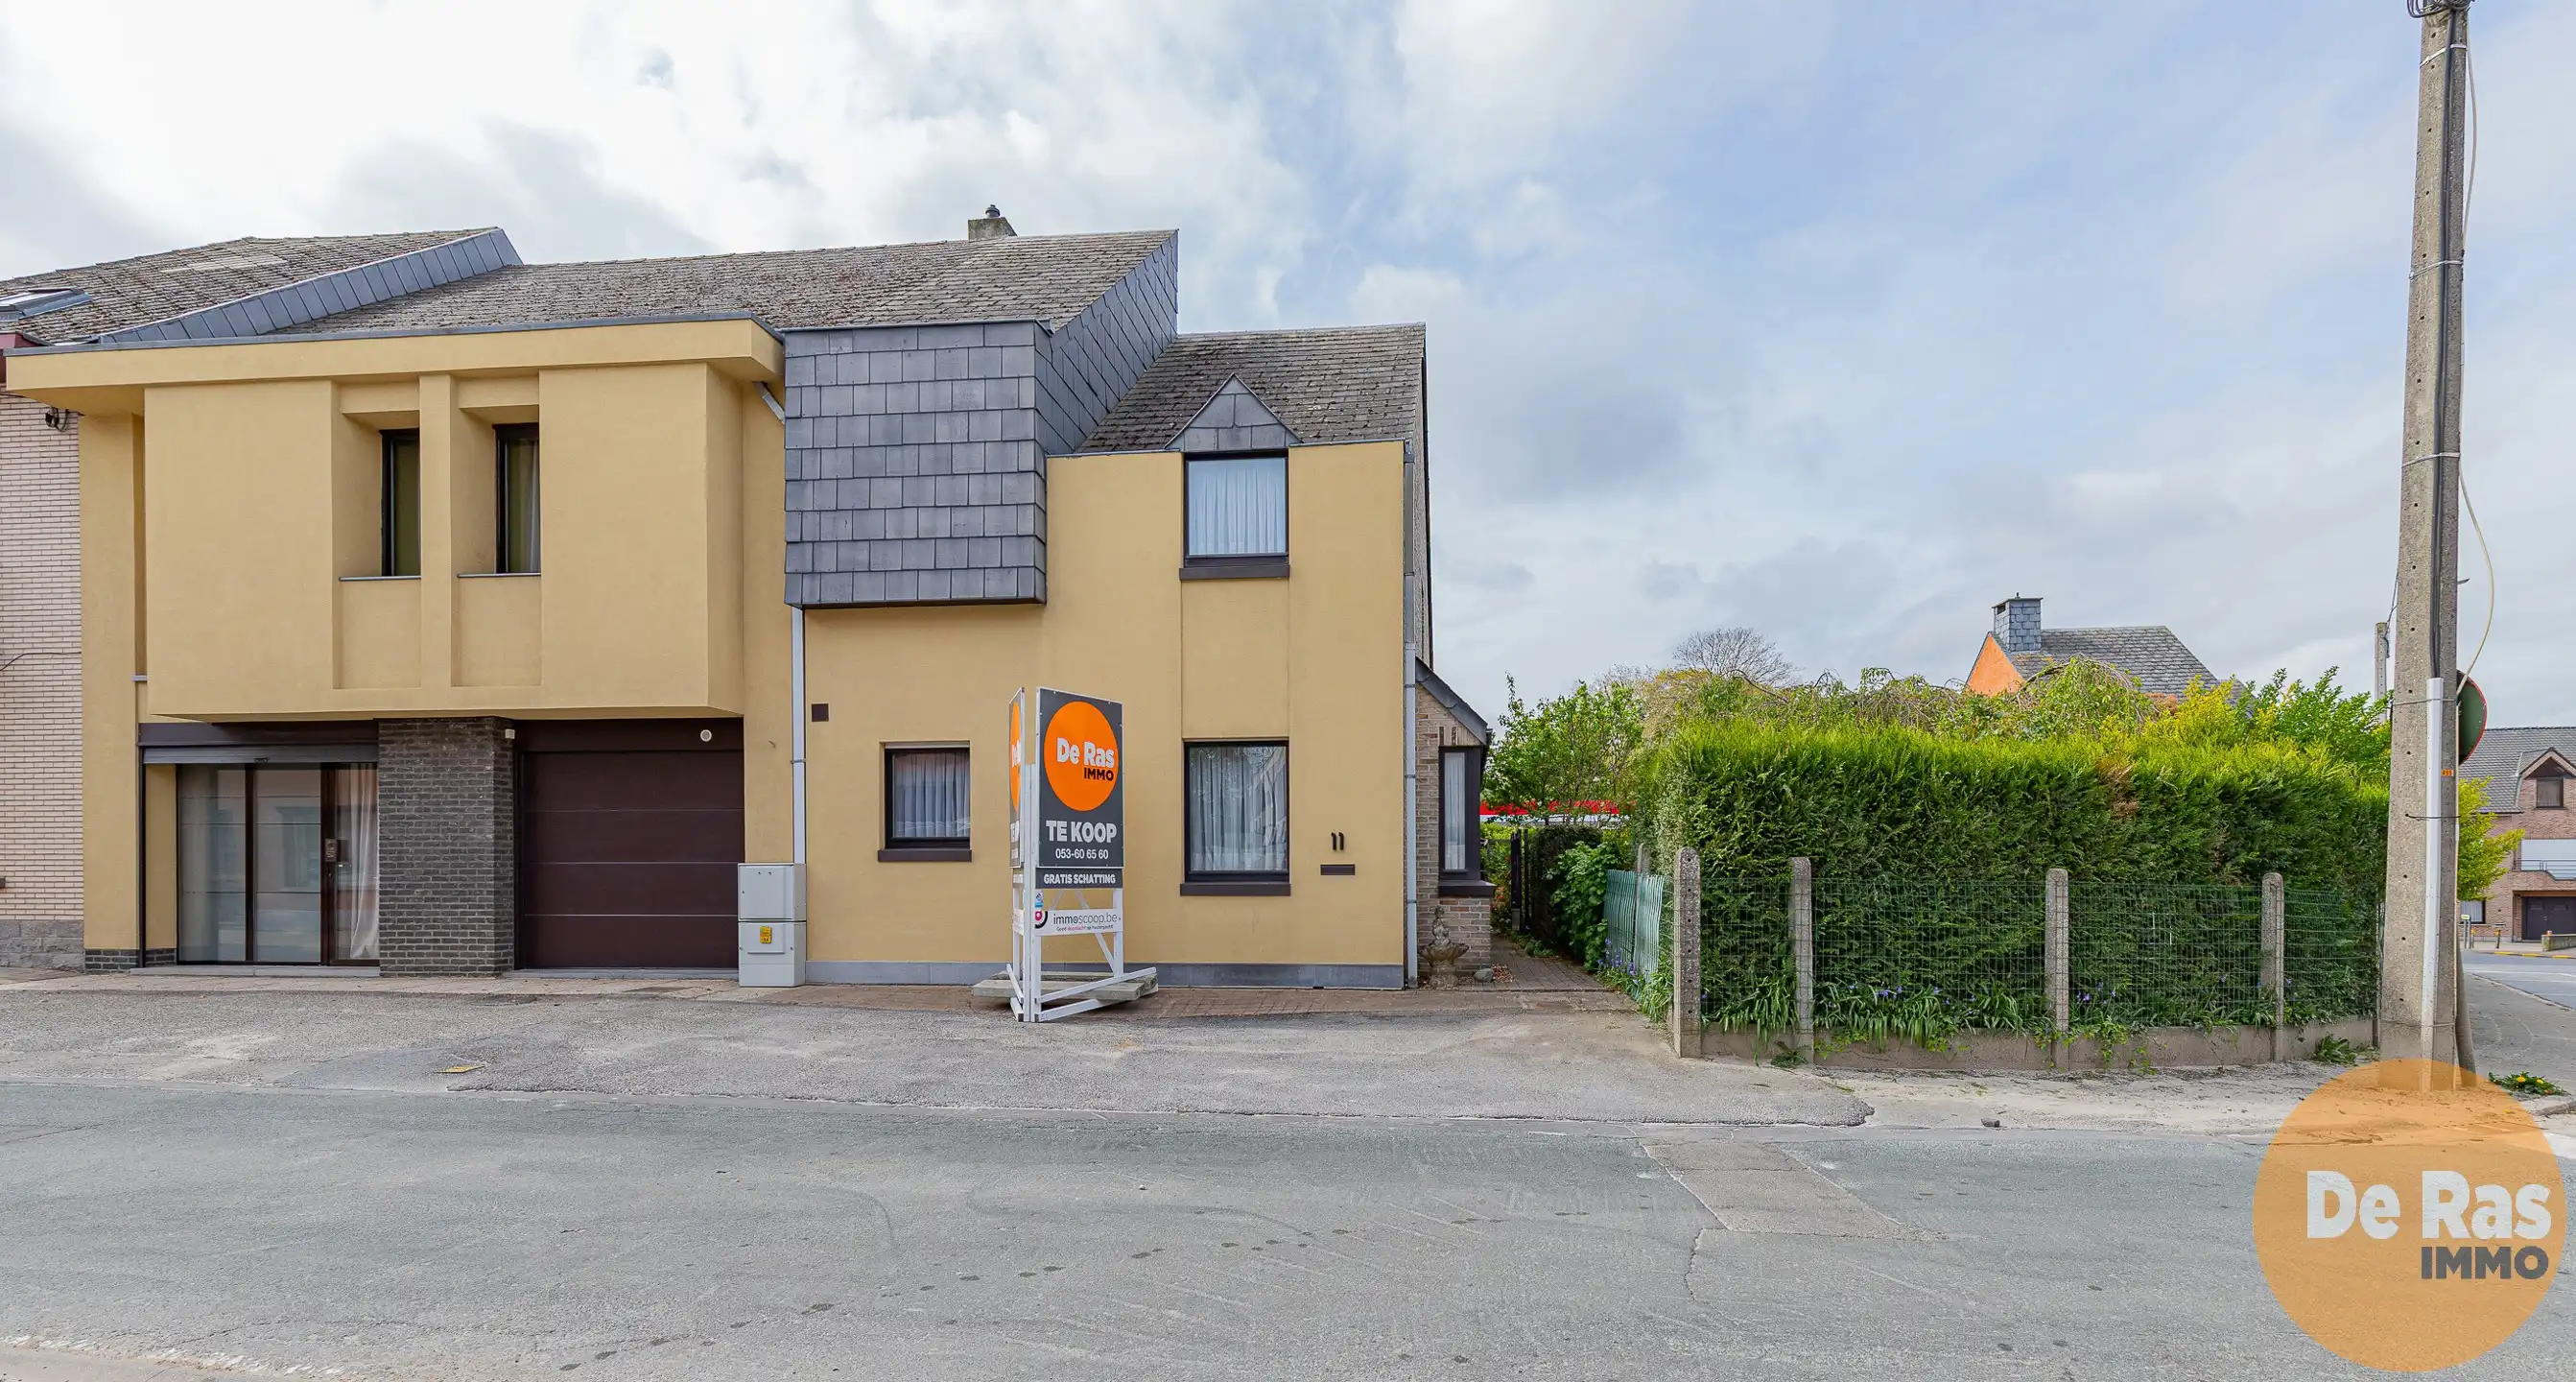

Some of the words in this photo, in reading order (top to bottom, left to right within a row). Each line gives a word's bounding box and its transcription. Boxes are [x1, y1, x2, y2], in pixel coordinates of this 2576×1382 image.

[1057, 737, 1079, 765] De
[1084, 741, 1115, 768] Ras
[1084, 768, 1114, 781] IMMO
[1046, 820, 1068, 843] TE
[1071, 821, 1117, 844] KOOP
[1331, 831, 1345, 851] 11
[1055, 847, 1085, 860] 053-60
[1086, 848, 1097, 860] 65
[1099, 848, 1109, 860] 60
[1043, 873, 1073, 885] GRATIS
[1073, 873, 1117, 885] SCHATTING
[1052, 912, 1118, 925] immoscoop.be
